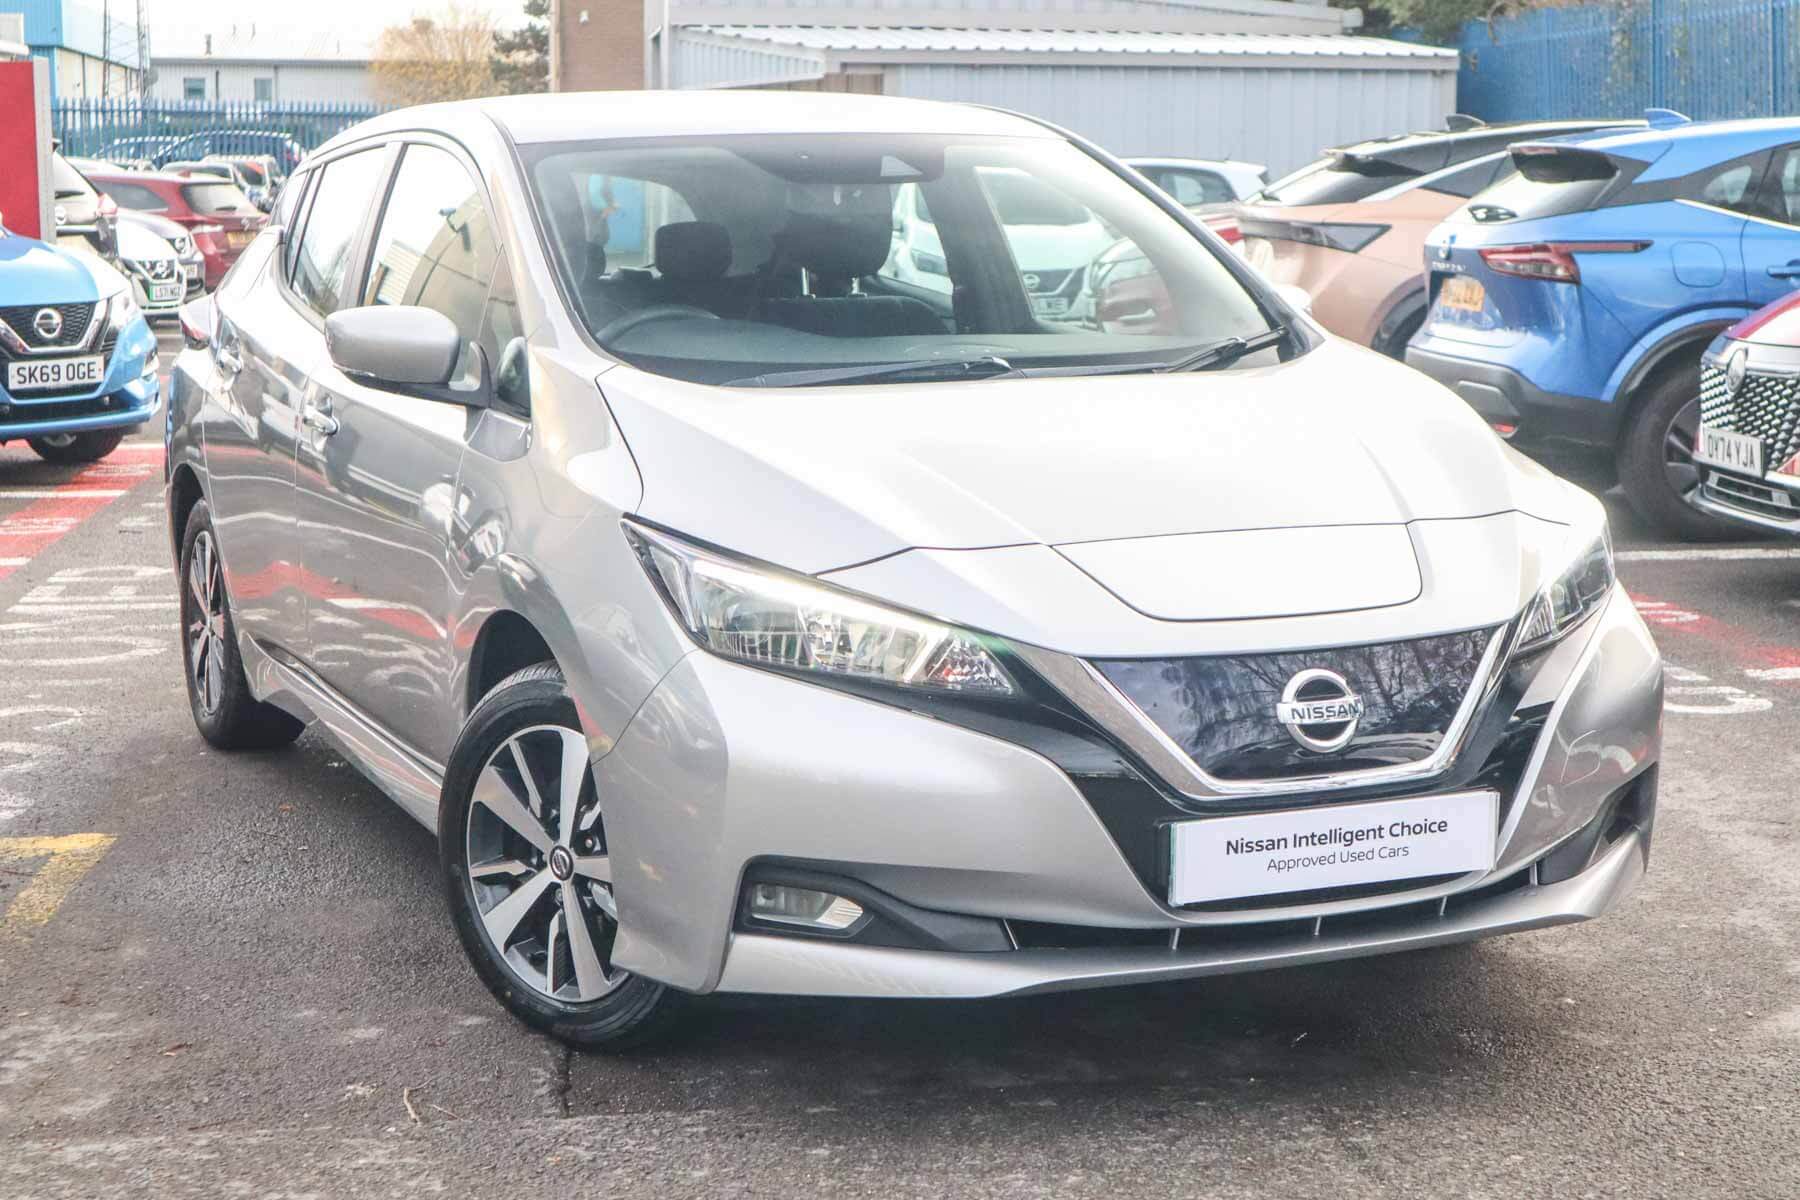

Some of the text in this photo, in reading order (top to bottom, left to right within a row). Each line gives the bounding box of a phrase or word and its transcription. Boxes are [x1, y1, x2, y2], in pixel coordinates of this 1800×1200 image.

[16, 361, 97, 385] SK69 OGE
[1734, 439, 1756, 469] YJA
[1291, 702, 1360, 720] NISSAN
[1226, 818, 1448, 855] Nissan Intelligent Choice
[1266, 845, 1409, 873] Approved Used Cars
